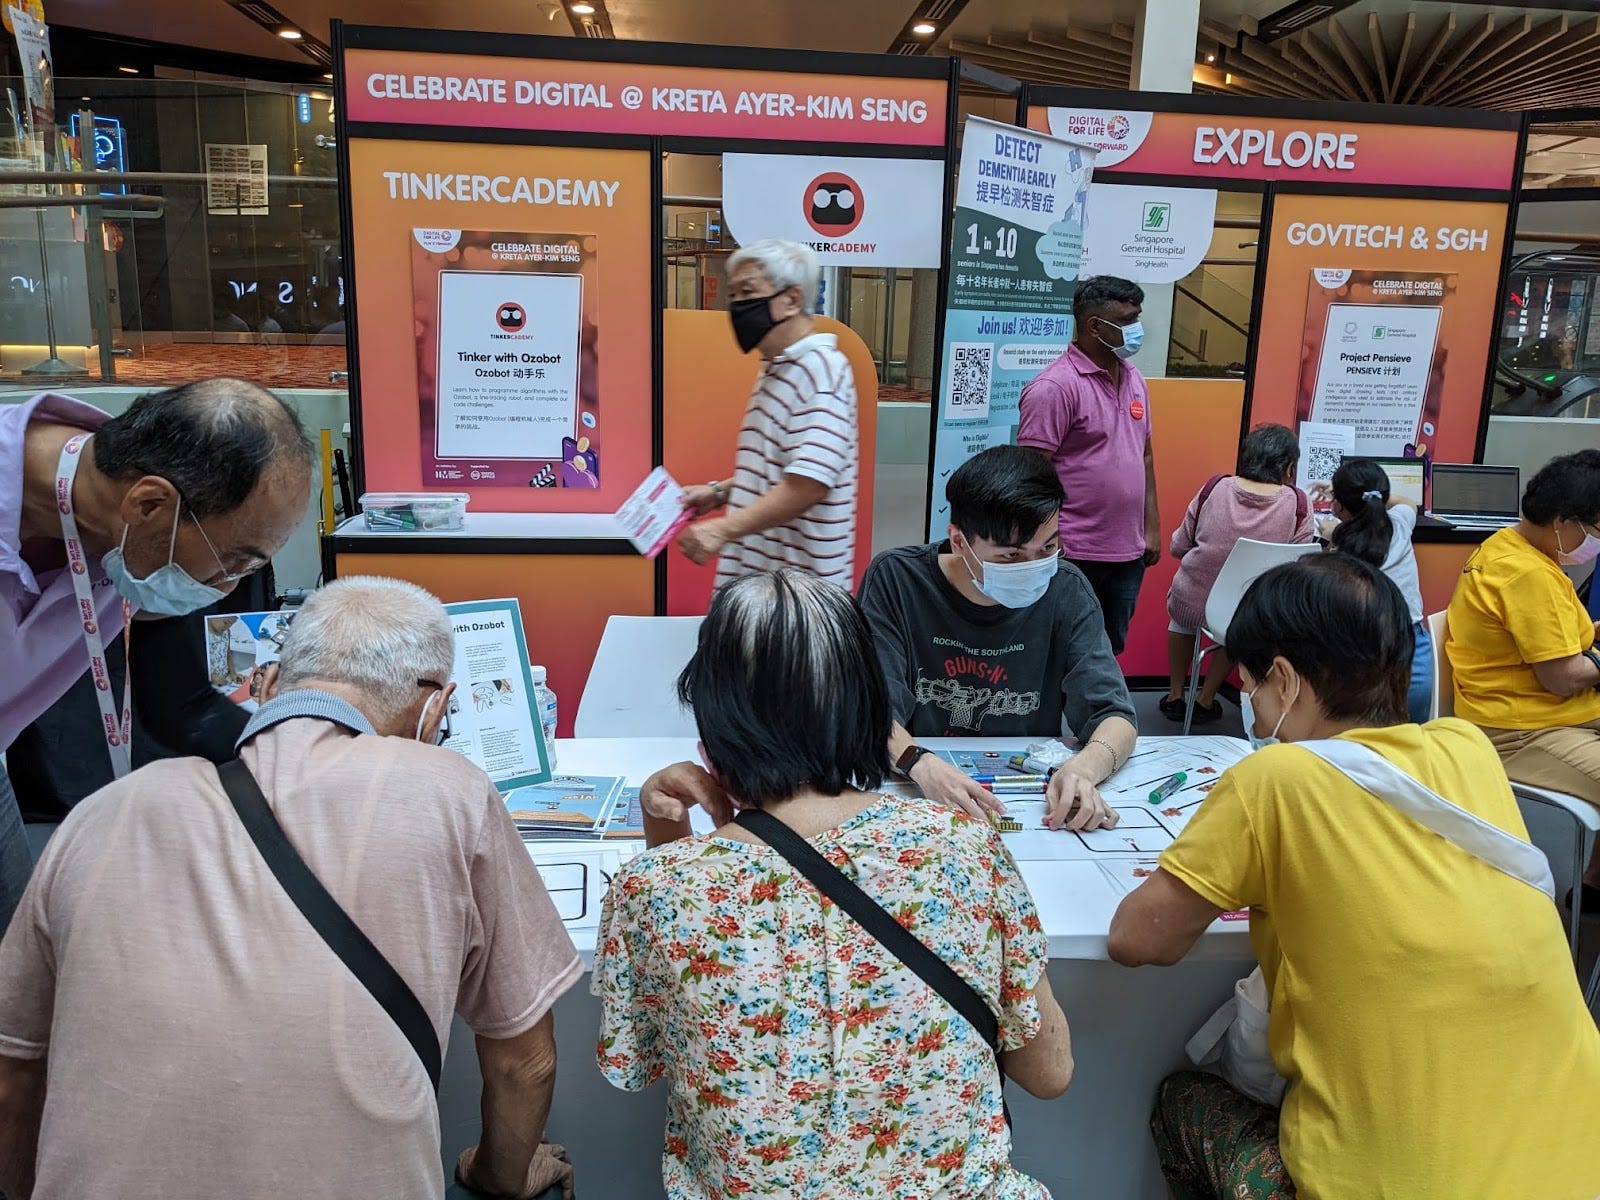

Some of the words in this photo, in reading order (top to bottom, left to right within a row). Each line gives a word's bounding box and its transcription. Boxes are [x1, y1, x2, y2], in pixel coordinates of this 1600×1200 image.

[366, 73, 507, 104] CELEBRATE
[514, 80, 614, 109] DIGITAL
[621, 86, 643, 109] @
[651, 87, 728, 114] KRETA
[734, 91, 854, 120] AYER-KIM
[861, 97, 928, 124] SENG
[1069, 116, 1106, 127] DIGITAL
[1068, 126, 1086, 135] FOR
[1088, 127, 1105, 136] LIFE
[994, 133, 1042, 164] DETECT
[1192, 126, 1360, 170] EXPLORE
[978, 159, 1026, 184] DEMENTIA
[1027, 168, 1057, 189] EARLY
[382, 171, 620, 207] TINKERCADEMY
[976, 181, 1054, 213] 提早检测失智症
[966, 223, 980, 255] 1
[983, 236, 992, 251] in
[995, 226, 1018, 259] 10
[1134, 234, 1174, 244] Singapore
[1287, 222, 1404, 248] GOVTECH
[1410, 226, 1428, 250] &
[1435, 227, 1489, 251] SGH
[491, 243, 541, 253] CELEBRATE
[543, 245, 580, 254] DIGITAL
[801, 242, 877, 253] KERCADEMY
[1121, 244, 1151, 253] General
[1153, 245, 1185, 255] Hospital
[500, 253, 523, 261] KRETA
[524, 254, 559, 262] AYER-KIM
[561, 254, 581, 263] SENG
[1135, 259, 1169, 268] SingHealth
[1373, 280, 1413, 289] CELEBRATE
[1415, 281, 1443, 290] DIGITAL
[1427, 289, 1443, 297] SENG
[977, 315, 1000, 335] Join
[1002, 316, 1017, 335] us!
[457, 352, 492, 362] Tinker
[494, 352, 518, 363] with
[521, 353, 561, 363] Ozobot
[1340, 353, 1370, 362] Project
[1372, 353, 1411, 363] Pensieve
[475, 368, 511, 378] Ozobot
[513, 368, 546, 379] 动手乐
[1346, 366, 1381, 375] PENSIEVE
[453, 624, 471, 633] ith
[472, 620, 506, 631] Ozobot
[964, 646, 979, 656] THE
[981, 643, 1025, 657] SOUTHLAND
